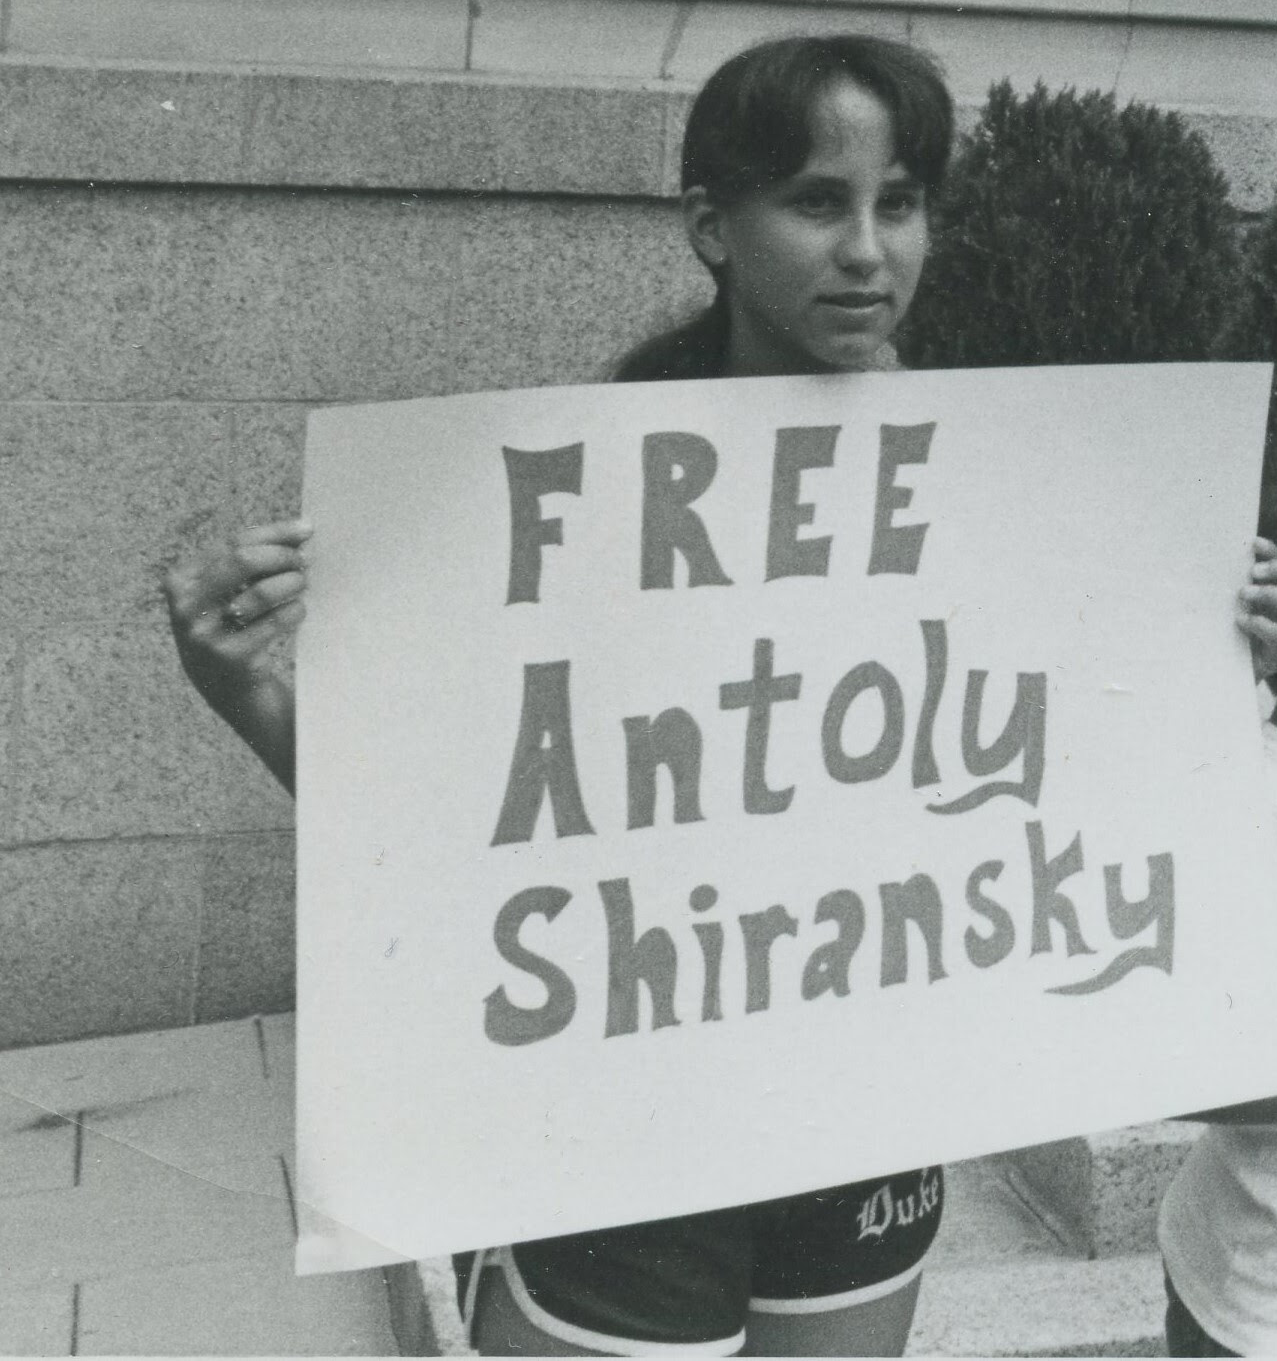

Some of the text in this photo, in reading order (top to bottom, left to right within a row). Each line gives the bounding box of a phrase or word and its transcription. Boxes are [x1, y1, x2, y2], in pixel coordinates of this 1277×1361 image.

[501, 421, 937, 606] FREE
[488, 619, 1048, 847] Antoly
[483, 819, 1176, 1047] Shiransky
[856, 1168, 939, 1241] Duke
